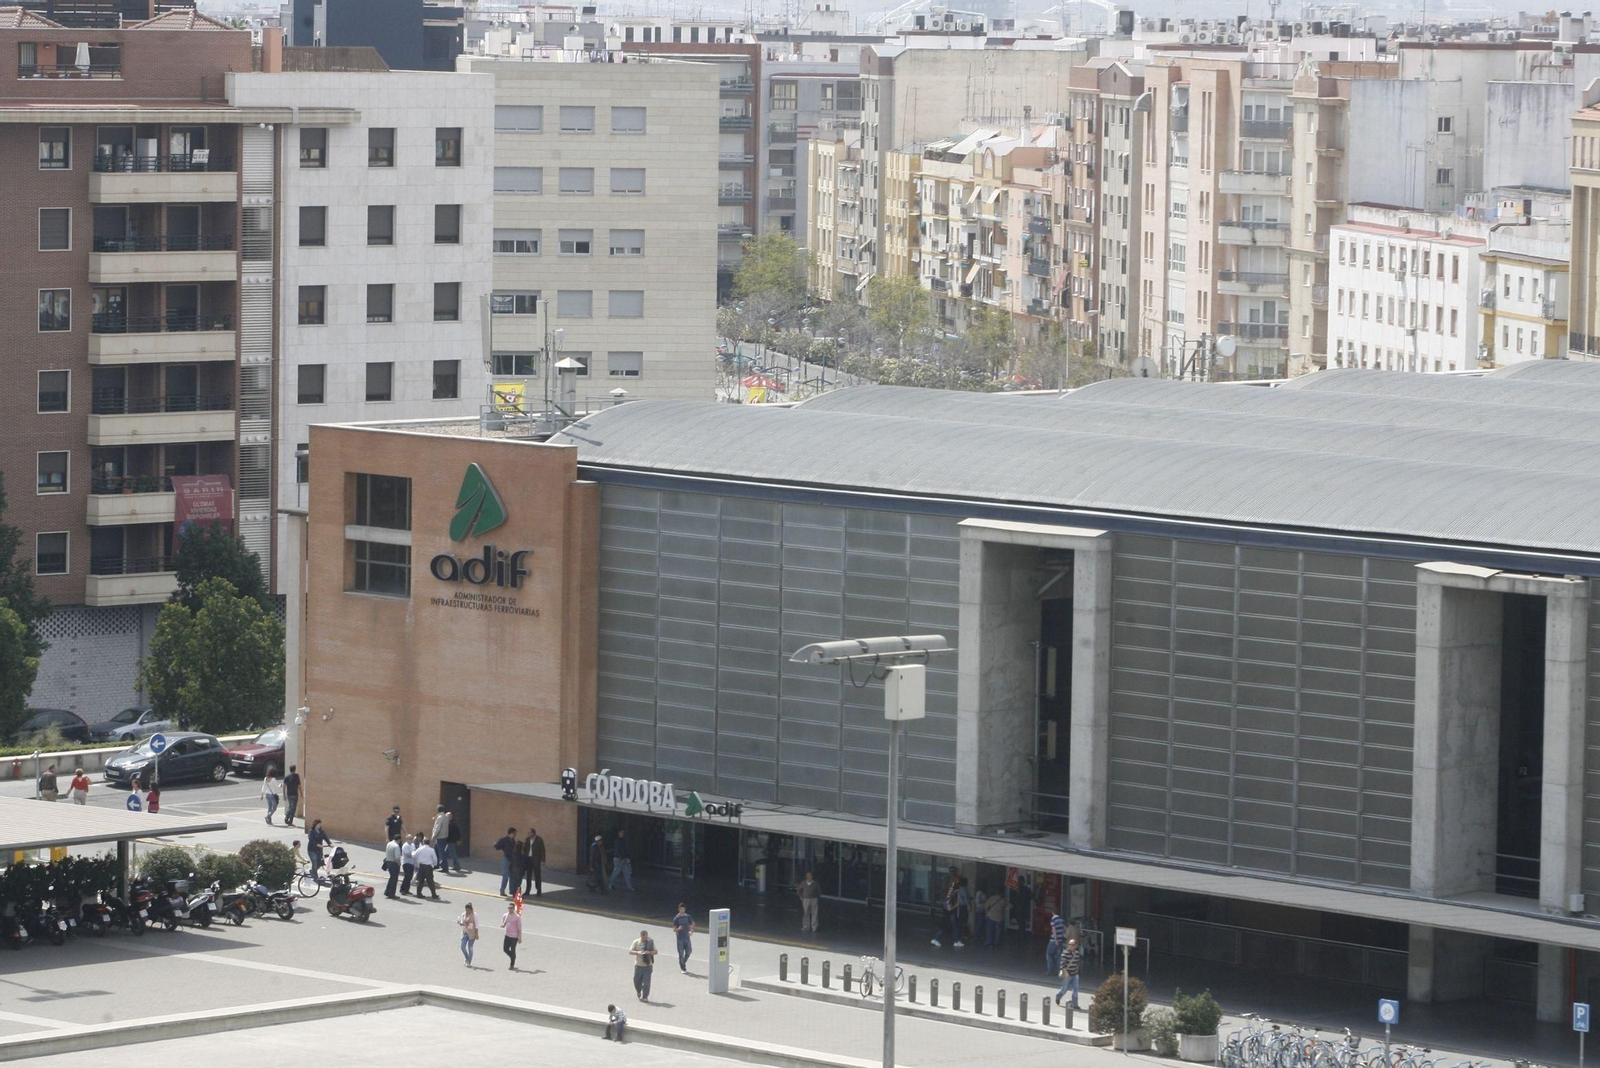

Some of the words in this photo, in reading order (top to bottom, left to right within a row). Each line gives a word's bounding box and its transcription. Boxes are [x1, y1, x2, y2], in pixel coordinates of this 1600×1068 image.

[430, 544, 534, 589] adif
[430, 597, 493, 612] INFRAESTRUCTURAS
[494, 605, 540, 617] FERROVIARIAS
[454, 591, 507, 605] ADMINISTRADOR
[508, 597, 517, 606] DE
[585, 769, 677, 810] CÓRDOBA
[705, 801, 744, 817] adif
[1576, 1006, 1586, 1019] P
